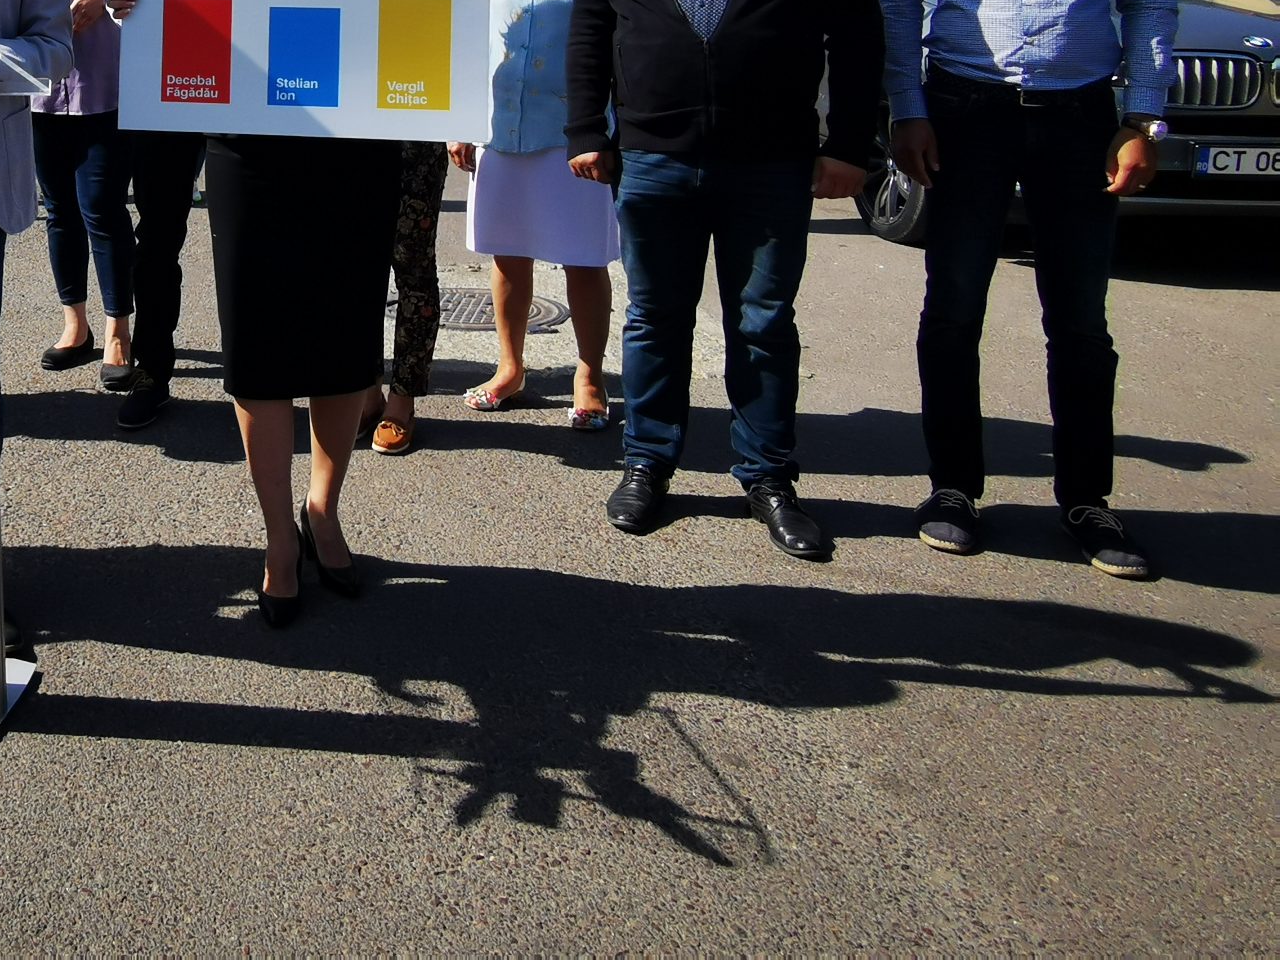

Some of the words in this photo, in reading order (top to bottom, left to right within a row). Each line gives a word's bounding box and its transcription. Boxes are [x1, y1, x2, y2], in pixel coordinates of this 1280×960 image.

[166, 74, 216, 86] Decebal
[276, 77, 319, 89] Stelian
[386, 80, 425, 94] Vergil
[166, 86, 219, 100] Făgădău
[276, 90, 296, 101] Ion
[386, 92, 428, 107] Chițac
[1212, 150, 1247, 172] CT
